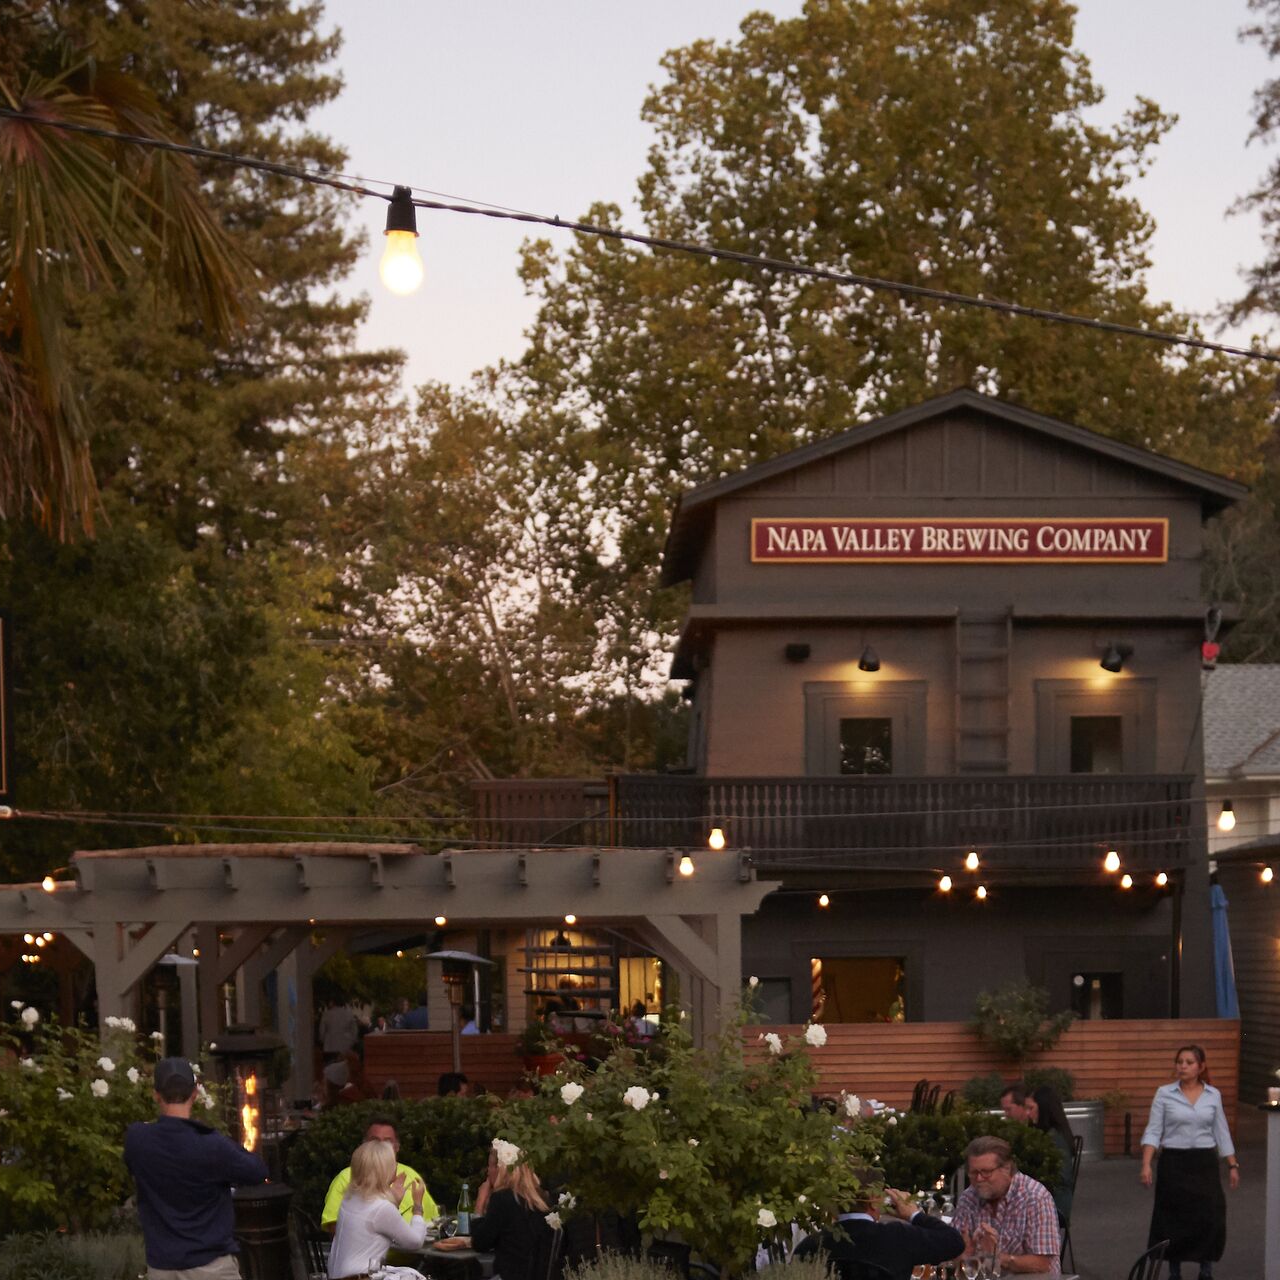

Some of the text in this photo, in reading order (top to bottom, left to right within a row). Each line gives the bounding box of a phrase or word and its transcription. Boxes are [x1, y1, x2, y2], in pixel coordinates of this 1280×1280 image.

[766, 524, 1153, 553] NAPA VALLEY BREWING COMPANY
